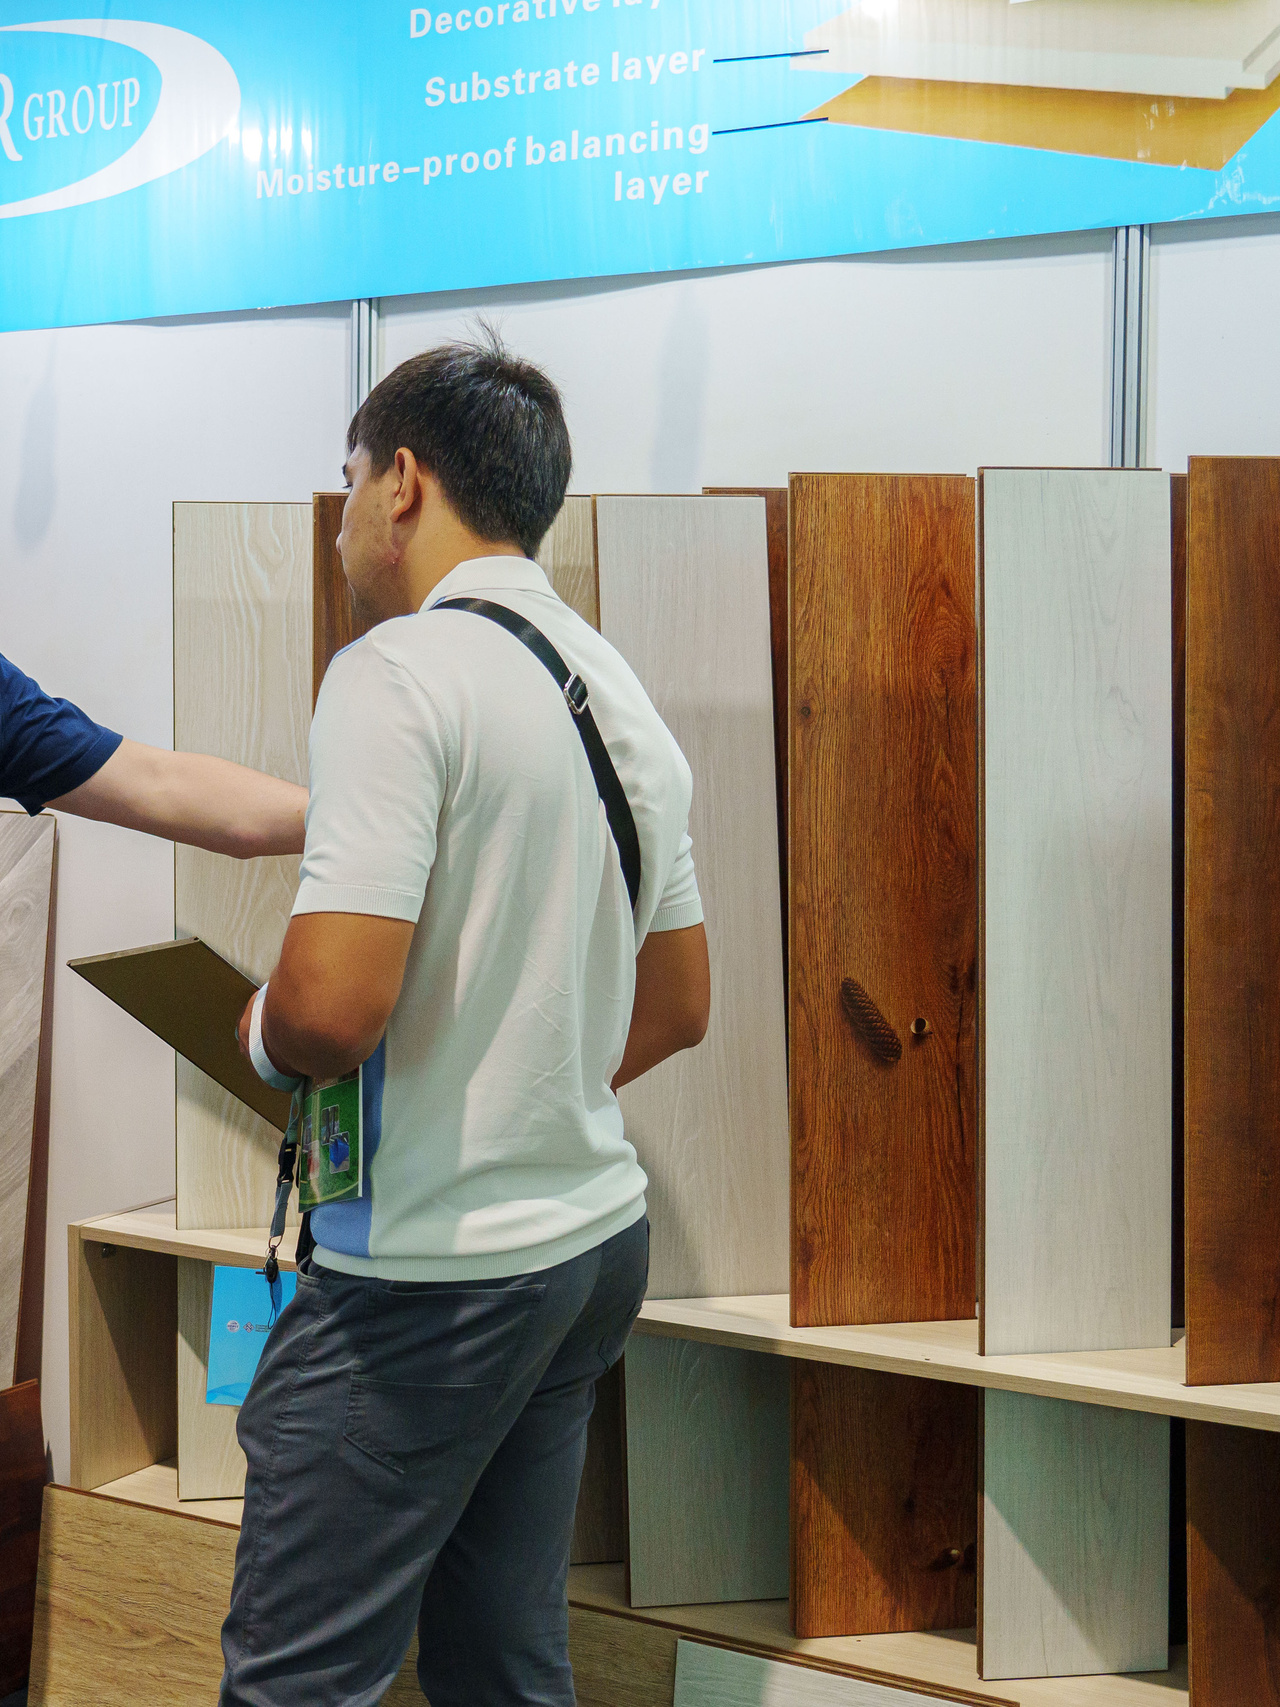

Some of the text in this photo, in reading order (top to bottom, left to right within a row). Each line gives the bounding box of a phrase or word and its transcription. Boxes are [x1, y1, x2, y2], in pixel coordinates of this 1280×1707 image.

[409, 0, 602, 38] Decorative
[424, 48, 706, 108] Substrate layer
[22, 76, 141, 142] GROUP
[525, 120, 710, 166] balancing
[614, 168, 710, 205] layer
